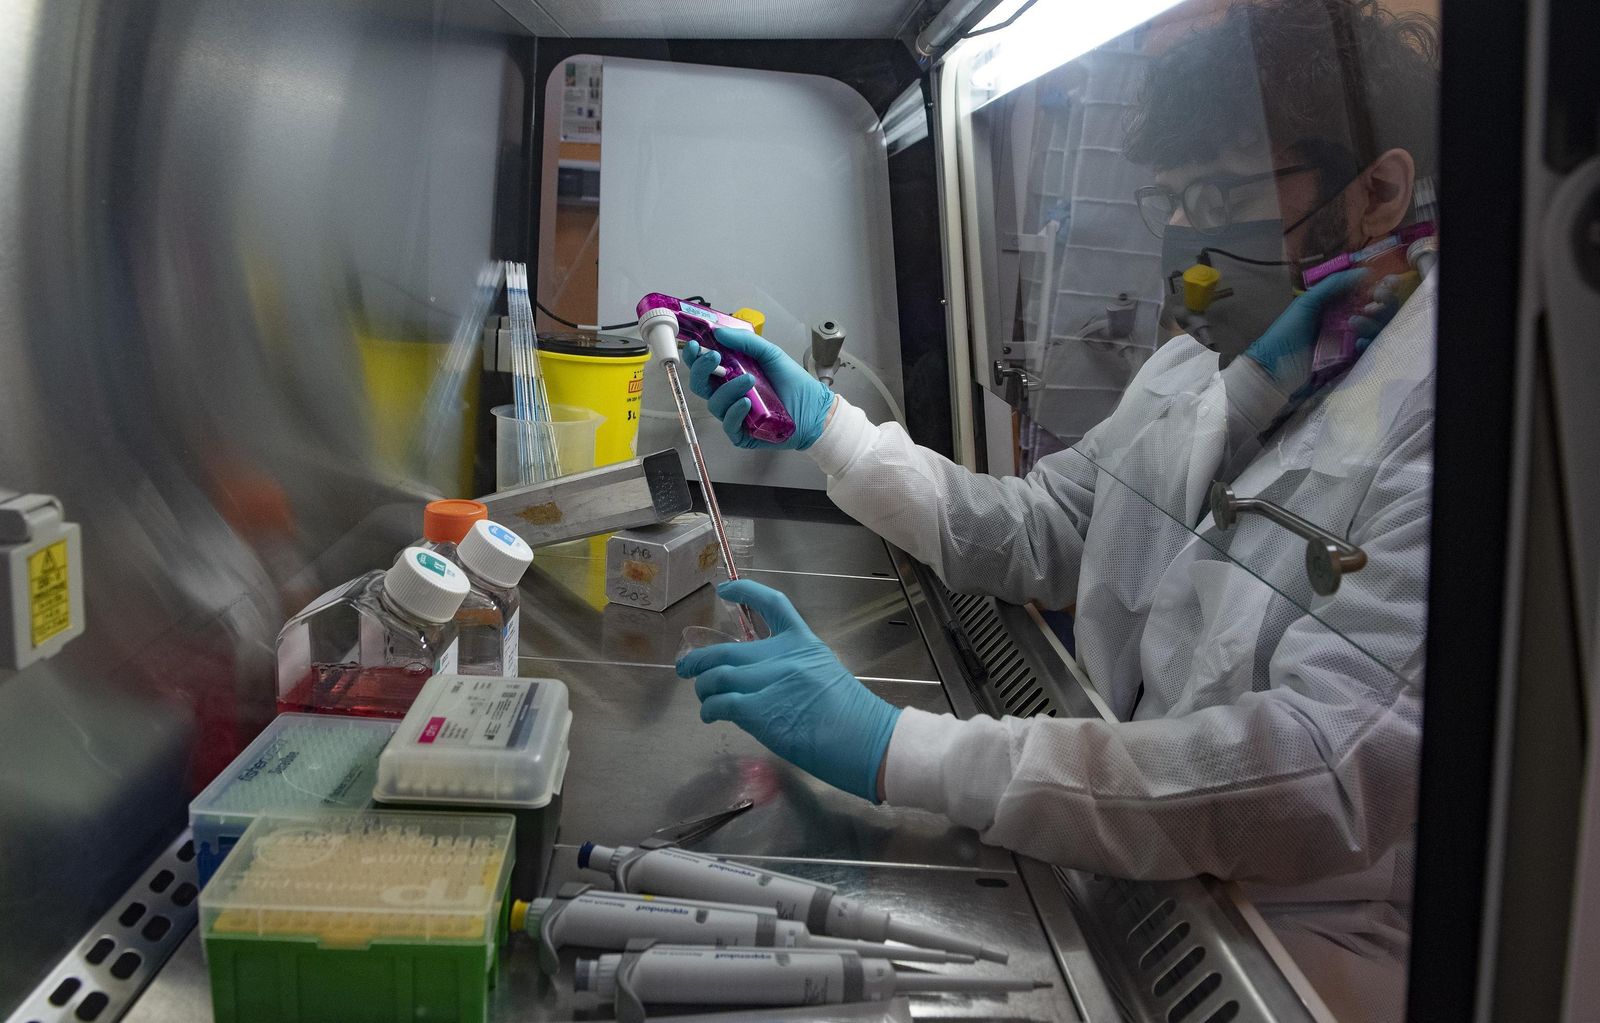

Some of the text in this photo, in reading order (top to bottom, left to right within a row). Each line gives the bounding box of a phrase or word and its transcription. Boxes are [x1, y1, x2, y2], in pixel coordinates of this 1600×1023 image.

[617, 587, 652, 606] 203
[708, 864, 756, 877] eppendorf
[635, 905, 689, 915] eppendorf
